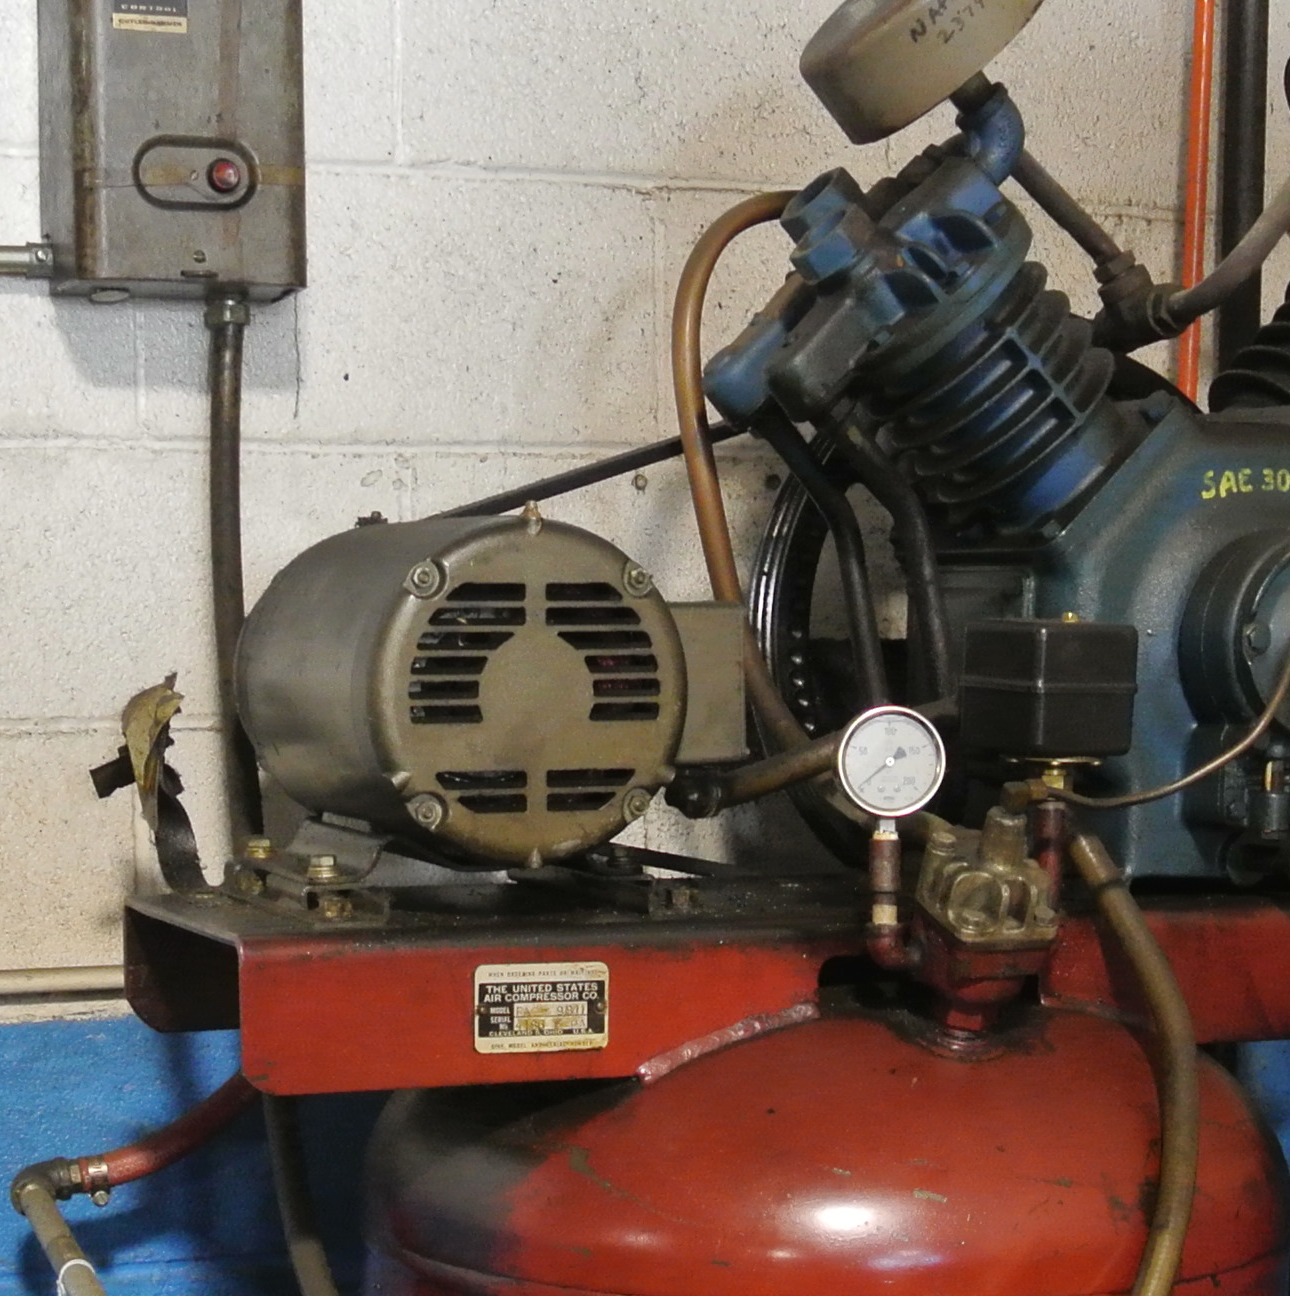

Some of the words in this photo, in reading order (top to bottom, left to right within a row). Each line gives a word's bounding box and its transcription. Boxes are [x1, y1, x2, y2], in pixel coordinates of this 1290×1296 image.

[1201, 468, 1253, 499] SAE
[1261, 468, 1290, 492] 30
[485, 984, 508, 994] THE
[512, 983, 553, 993] UNITED
[556, 982, 599, 992] STATES
[483, 994, 502, 1003] AIR
[505, 992, 579, 1002] COMPRESSOR
